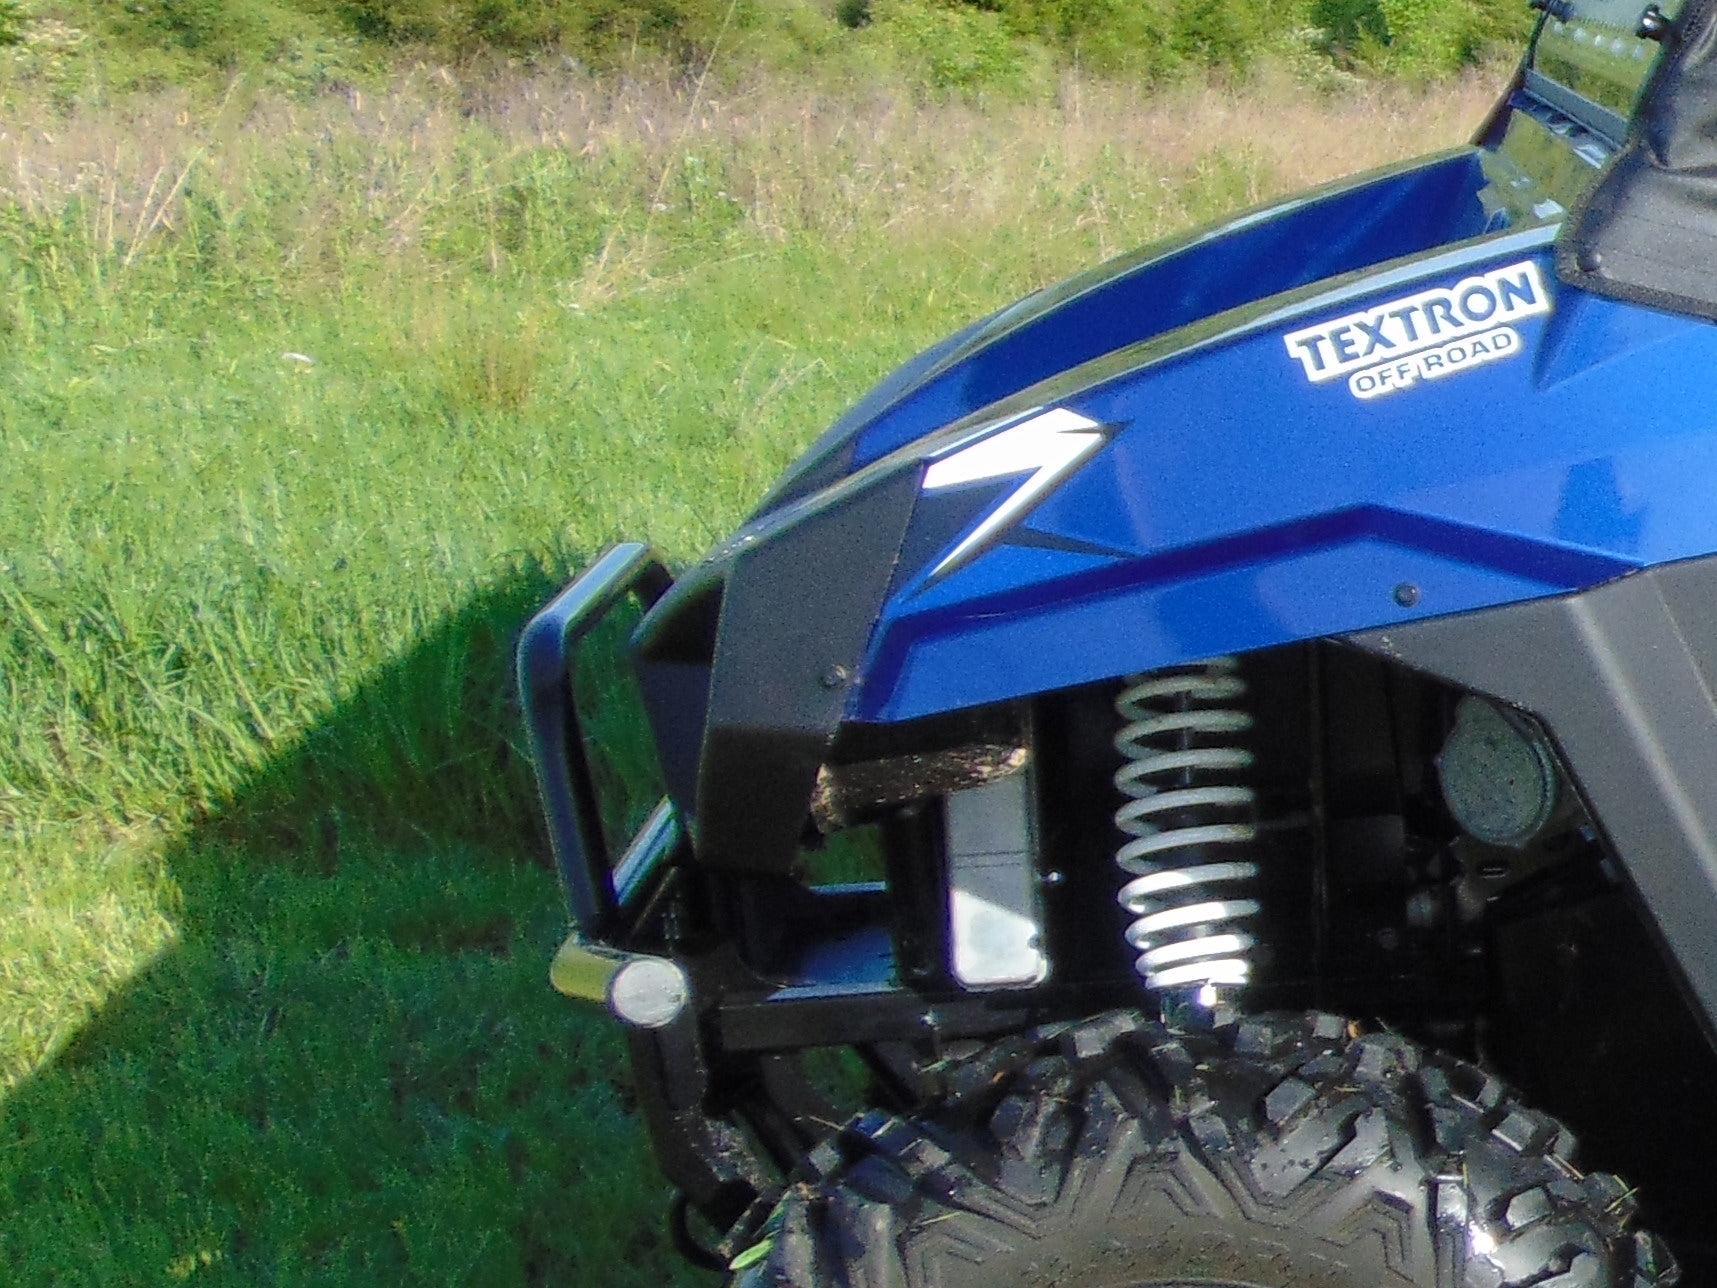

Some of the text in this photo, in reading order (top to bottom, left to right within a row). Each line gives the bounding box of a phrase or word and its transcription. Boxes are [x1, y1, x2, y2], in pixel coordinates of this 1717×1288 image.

[1296, 271, 1537, 372] TEXTRON
[1355, 332, 1513, 393] OFF ROAD
